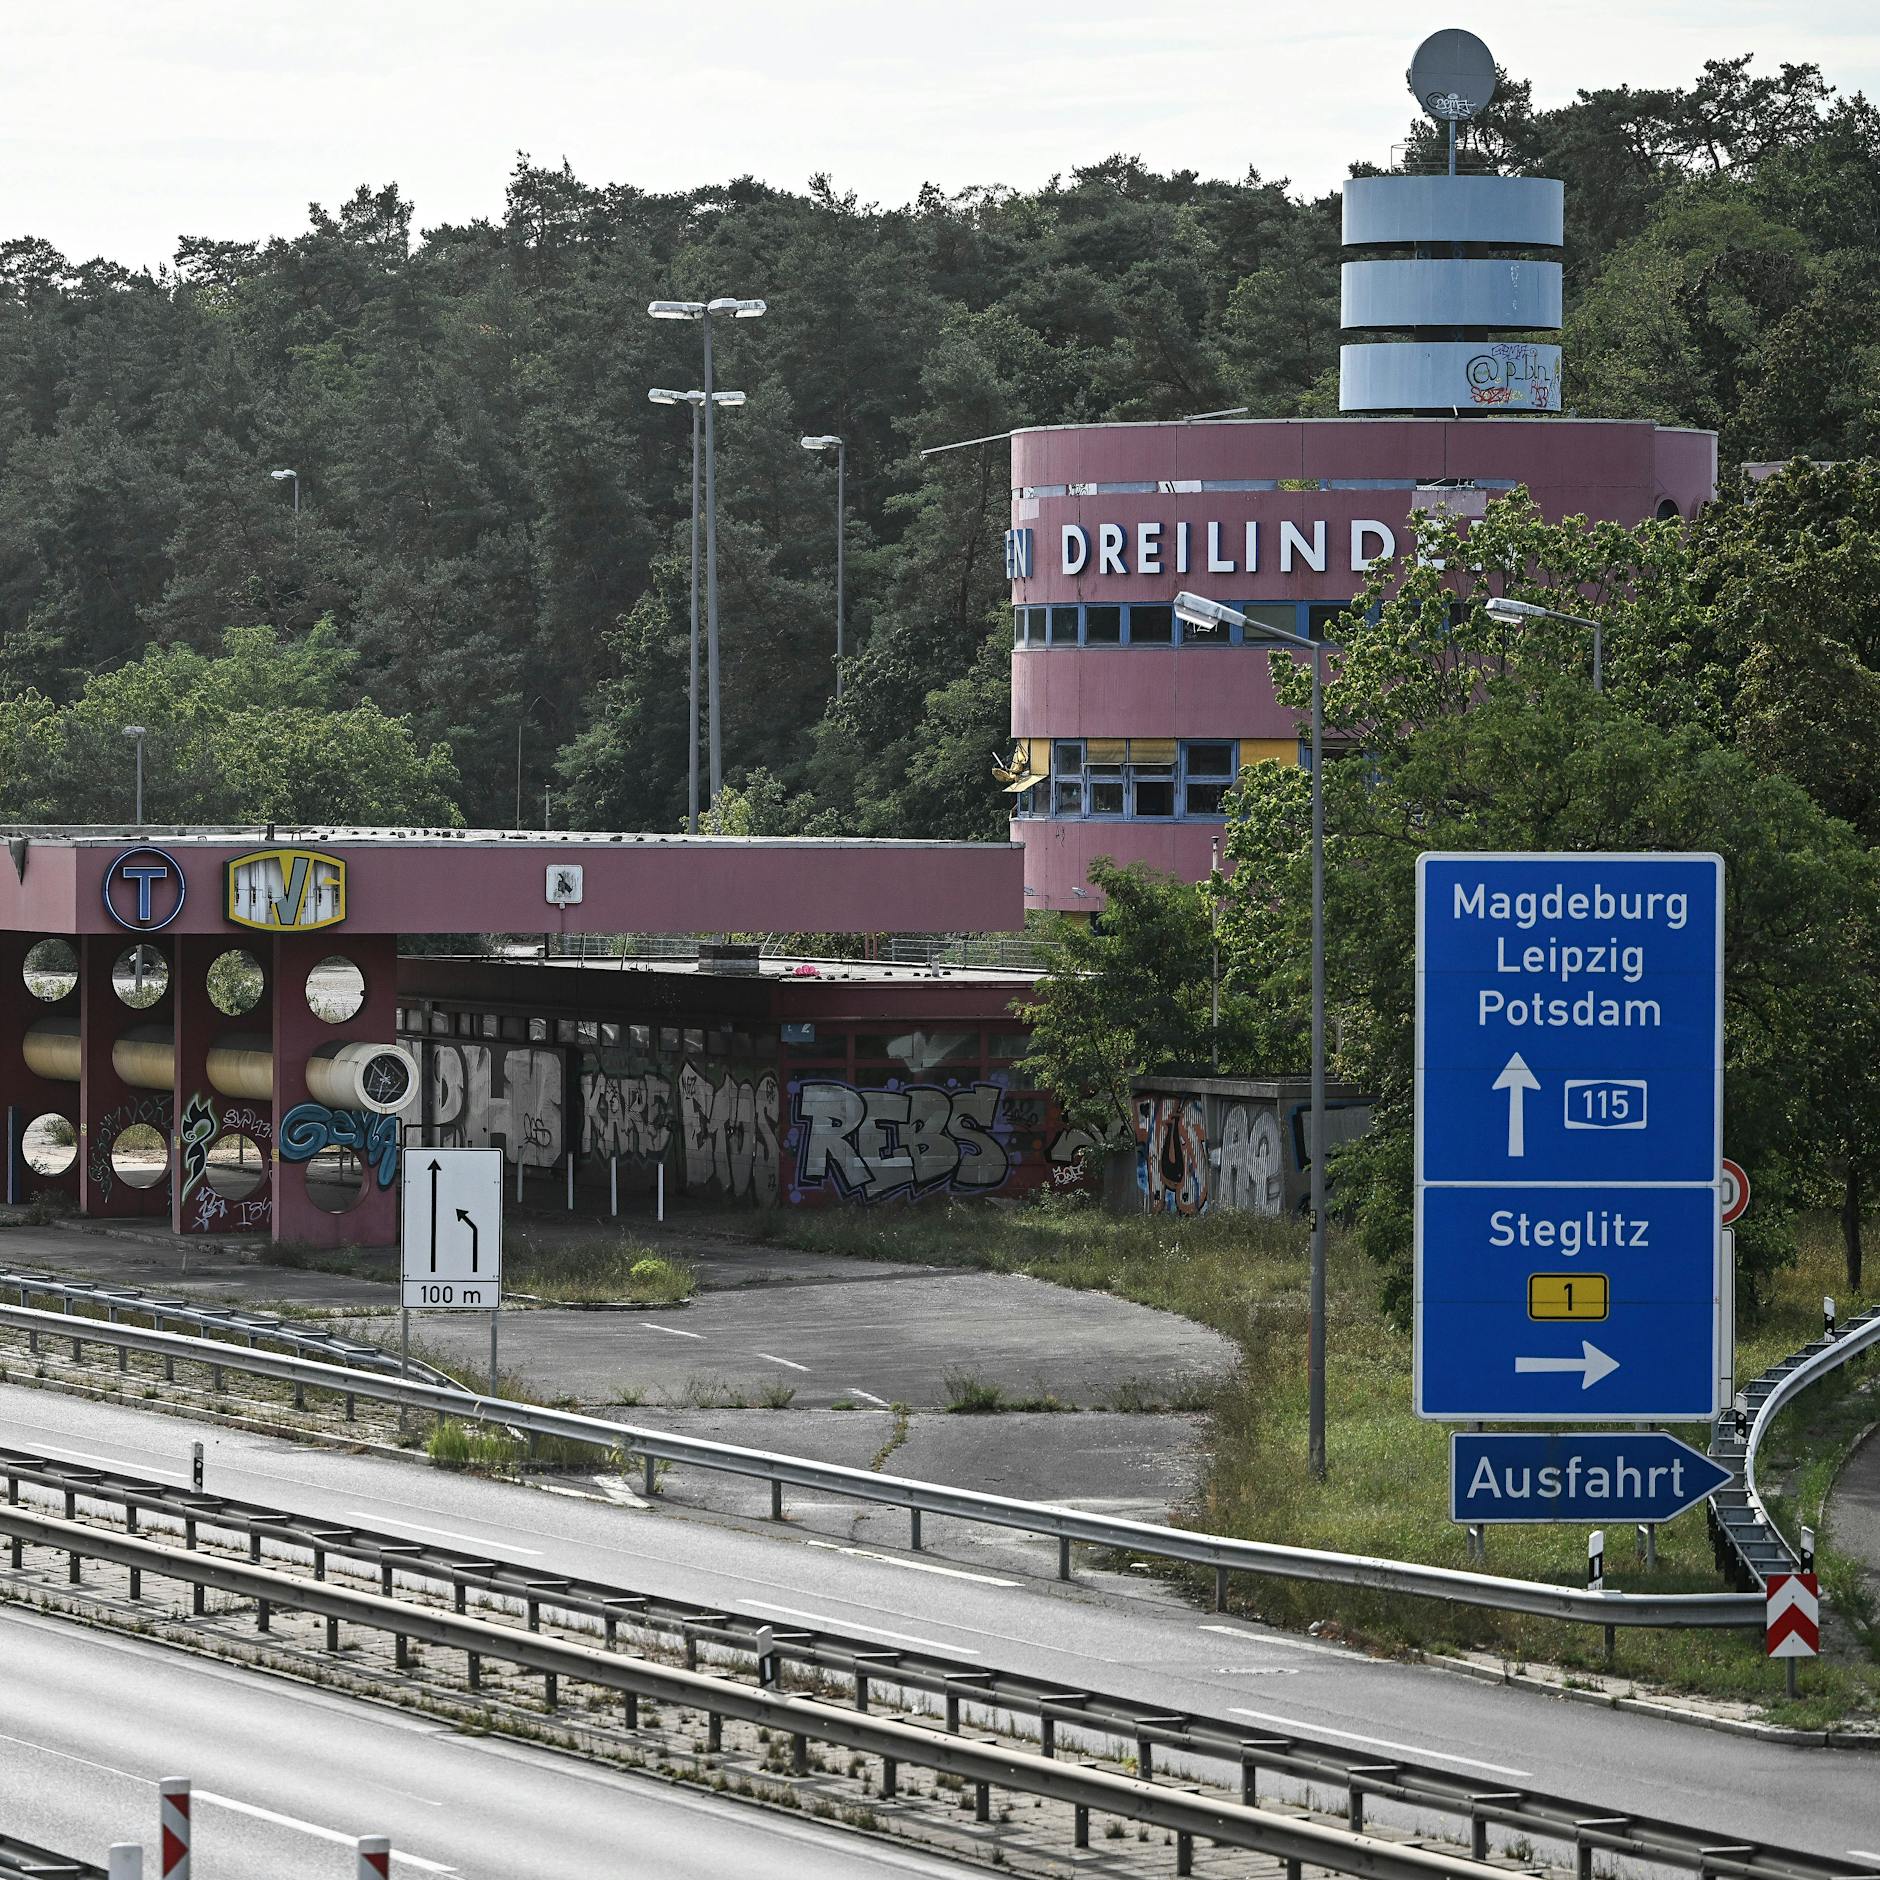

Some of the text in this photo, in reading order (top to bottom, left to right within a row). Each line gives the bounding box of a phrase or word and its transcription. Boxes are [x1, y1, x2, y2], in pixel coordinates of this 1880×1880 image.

[1454, 884, 1687, 929] Magdeburg
[1498, 937, 1642, 982] Leipzig
[1480, 991, 1660, 1026] Potsdam
[1582, 1090, 1629, 1119] 115
[797, 1079, 1010, 1202] REBS
[1490, 1211, 1648, 1256] Steglitz
[421, 1286, 480, 1303] 100 m
[1563, 1283, 1573, 1311] 1
[1466, 1456, 1684, 1498] Ausfahrt
